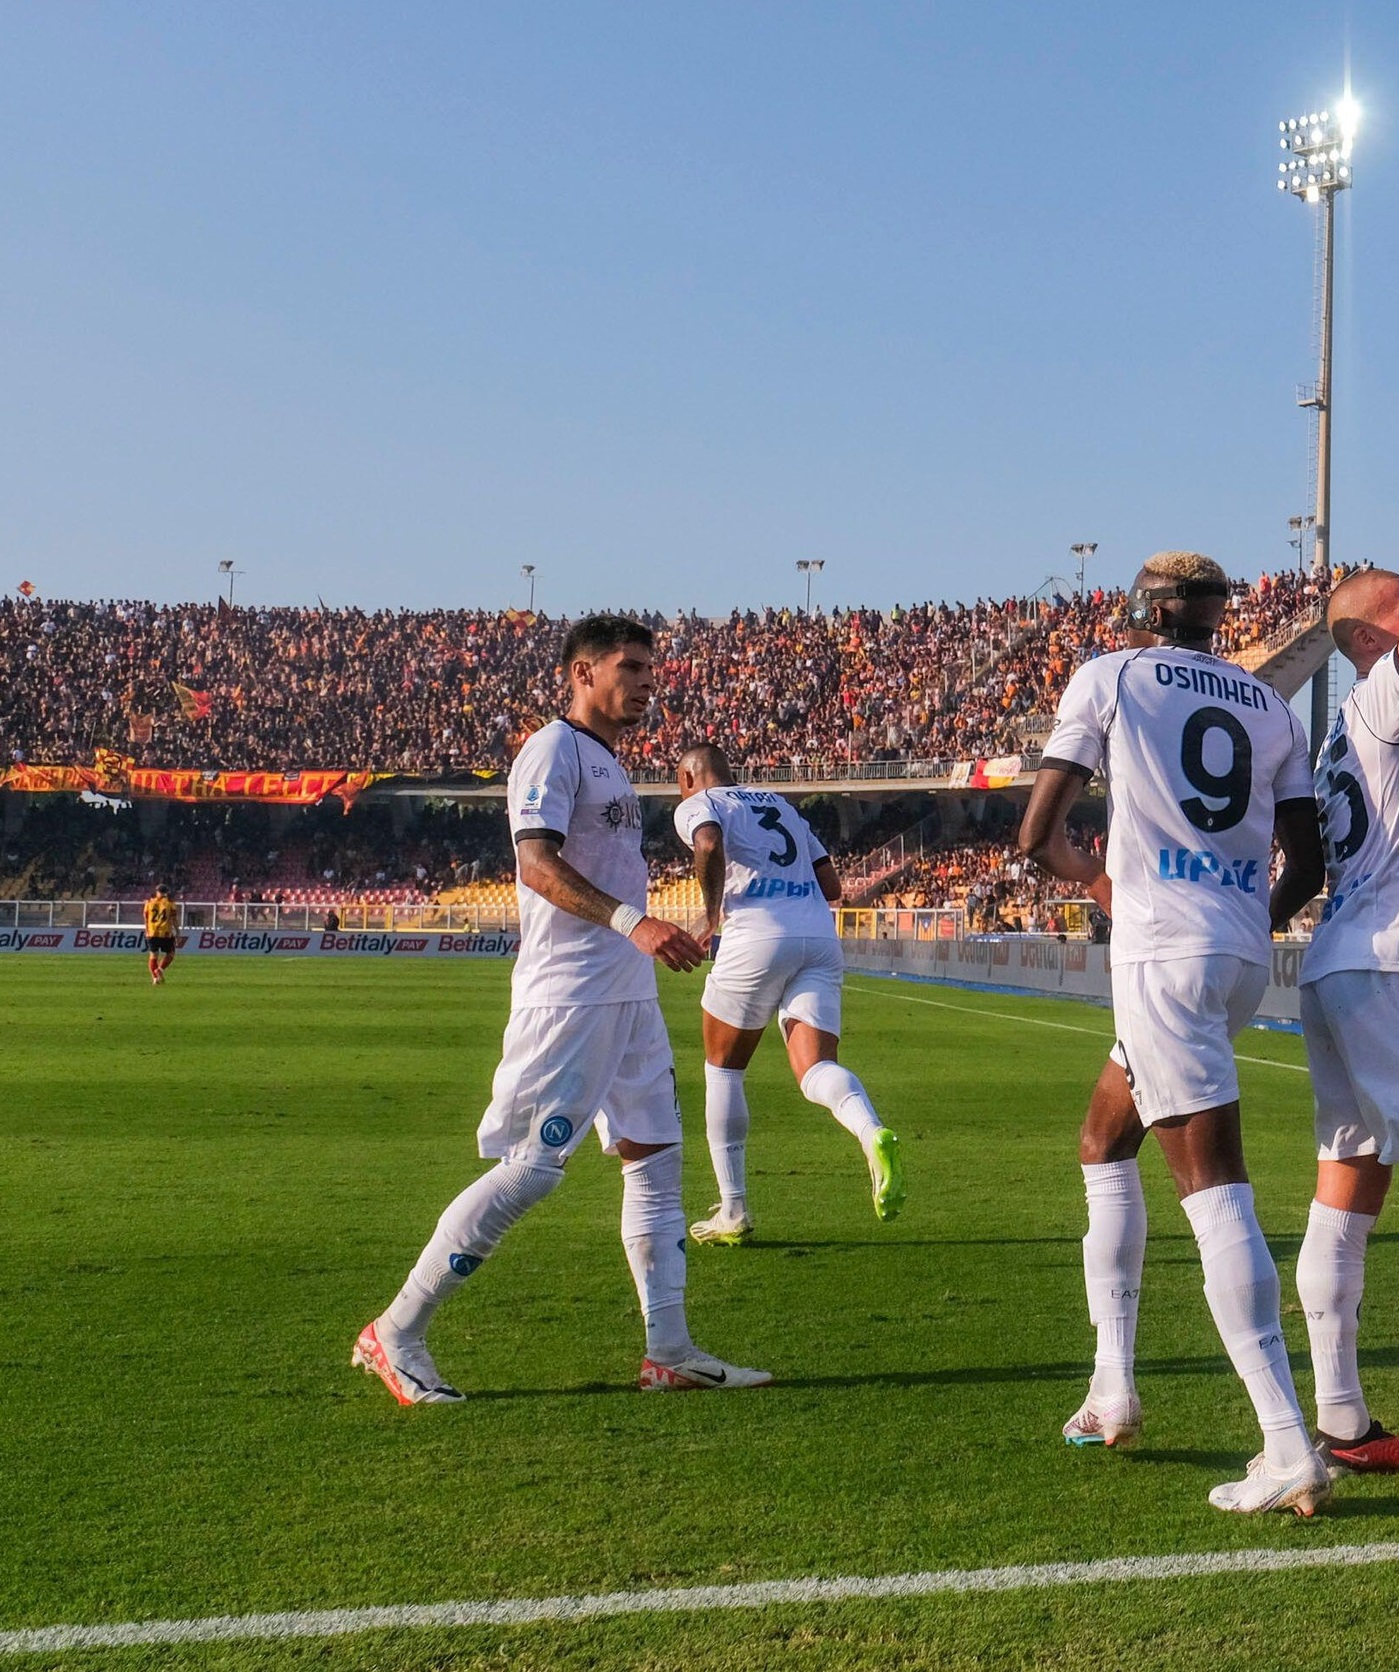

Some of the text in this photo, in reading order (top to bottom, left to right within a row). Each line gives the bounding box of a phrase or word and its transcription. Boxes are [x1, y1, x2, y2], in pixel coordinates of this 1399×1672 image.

[1156, 663, 1268, 711] OSIMHEN
[1180, 706, 1252, 833] 9
[750, 805, 798, 868] 3
[0, 930, 30, 951] aly
[34, 936, 57, 946] PAY
[199, 931, 280, 953] Betitaly
[283, 938, 305, 949] PAY
[320, 933, 398, 955] Betitaly
[401, 940, 423, 951] PAY
[438, 934, 514, 956] Betitaly
[1111, 1289, 1139, 1300] EA7
[1307, 1311, 1325, 1320] A7
